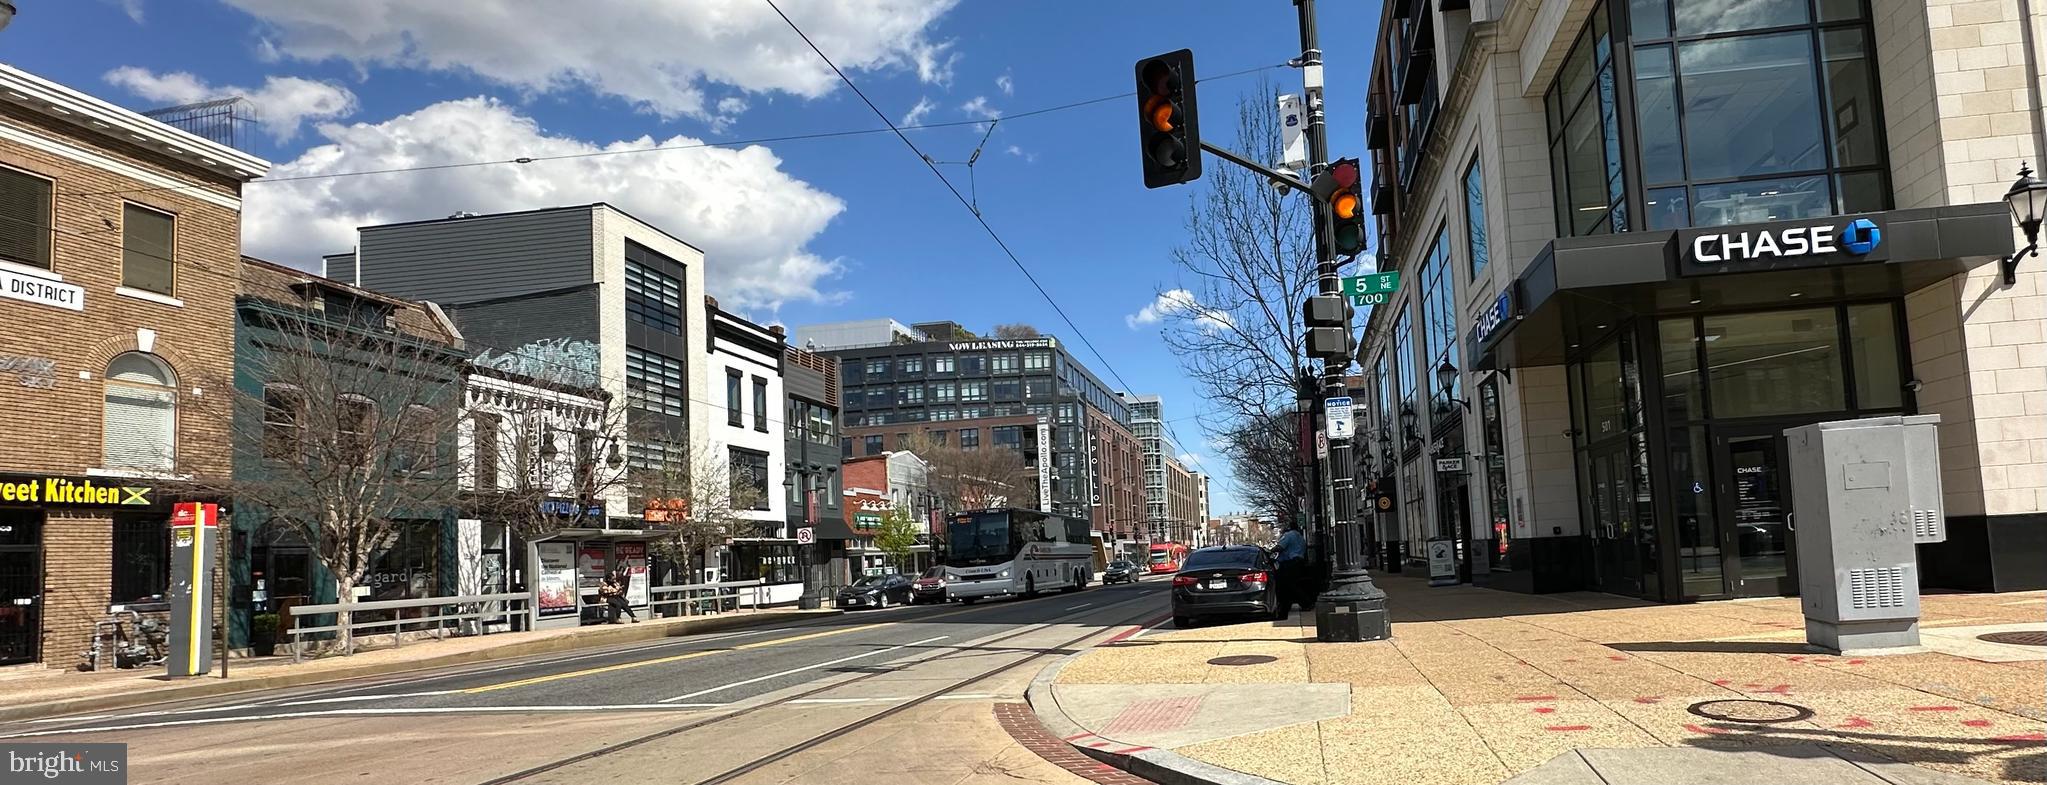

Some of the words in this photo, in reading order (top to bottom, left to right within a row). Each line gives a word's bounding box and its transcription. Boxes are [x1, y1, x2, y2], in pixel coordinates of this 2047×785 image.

[1693, 225, 1838, 263] CHASE
[11, 279, 75, 304] DISTRICT
[1356, 278, 1367, 293] 5
[1380, 275, 1391, 283] ST
[1380, 282, 1392, 290] NE
[1358, 293, 1383, 305] 700
[1476, 301, 1500, 343] CHASE
[949, 342, 970, 351] NOW
[971, 340, 1014, 350] LEASING
[1601, 420, 1611, 433] 501
[1040, 428, 1050, 506] LiveTheApollo.com
[1090, 434, 1100, 501] APOLLO
[1737, 466, 1762, 474] CHASE
[45, 478, 119, 504] Kitchen
